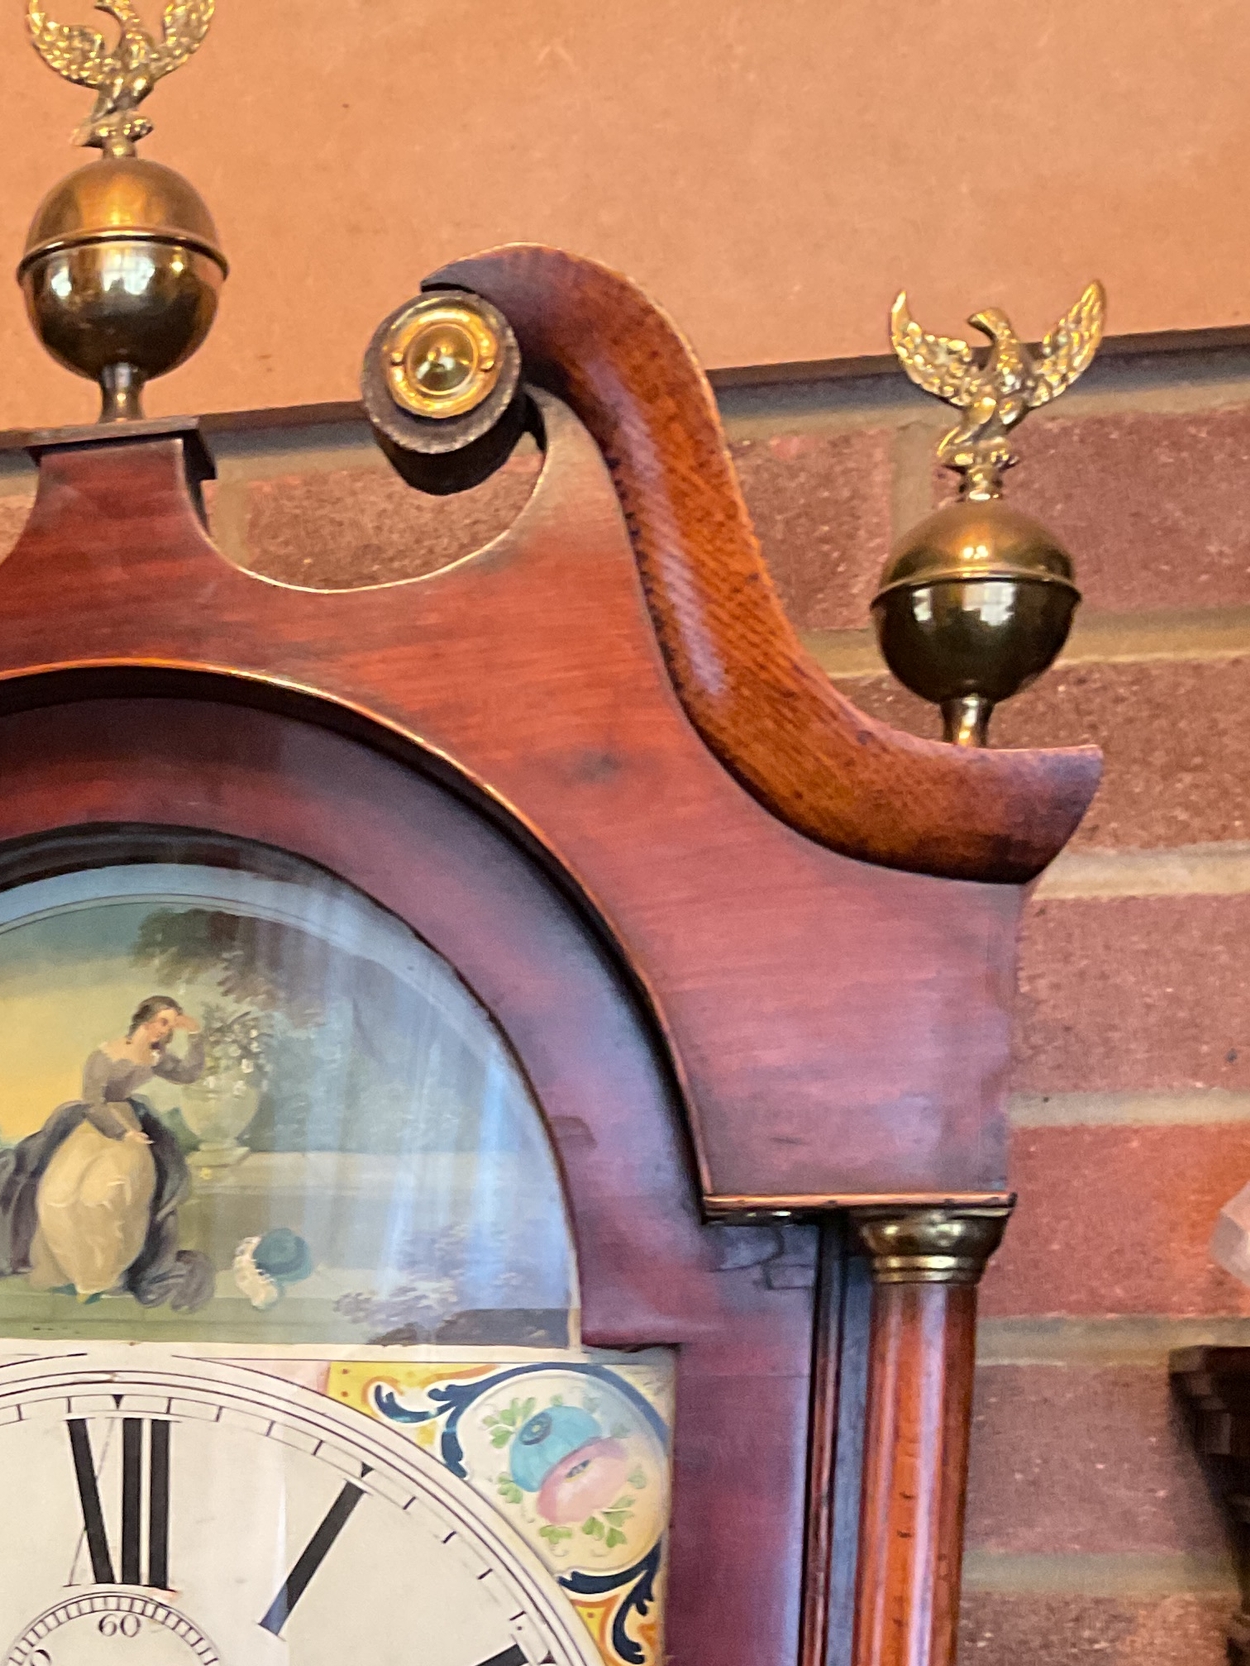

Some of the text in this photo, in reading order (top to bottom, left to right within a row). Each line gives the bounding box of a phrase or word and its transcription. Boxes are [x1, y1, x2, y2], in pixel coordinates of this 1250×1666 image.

[60, 1415, 183, 1592] XII
[257, 1476, 368, 1640] I
[98, 1614, 141, 1637] 60
